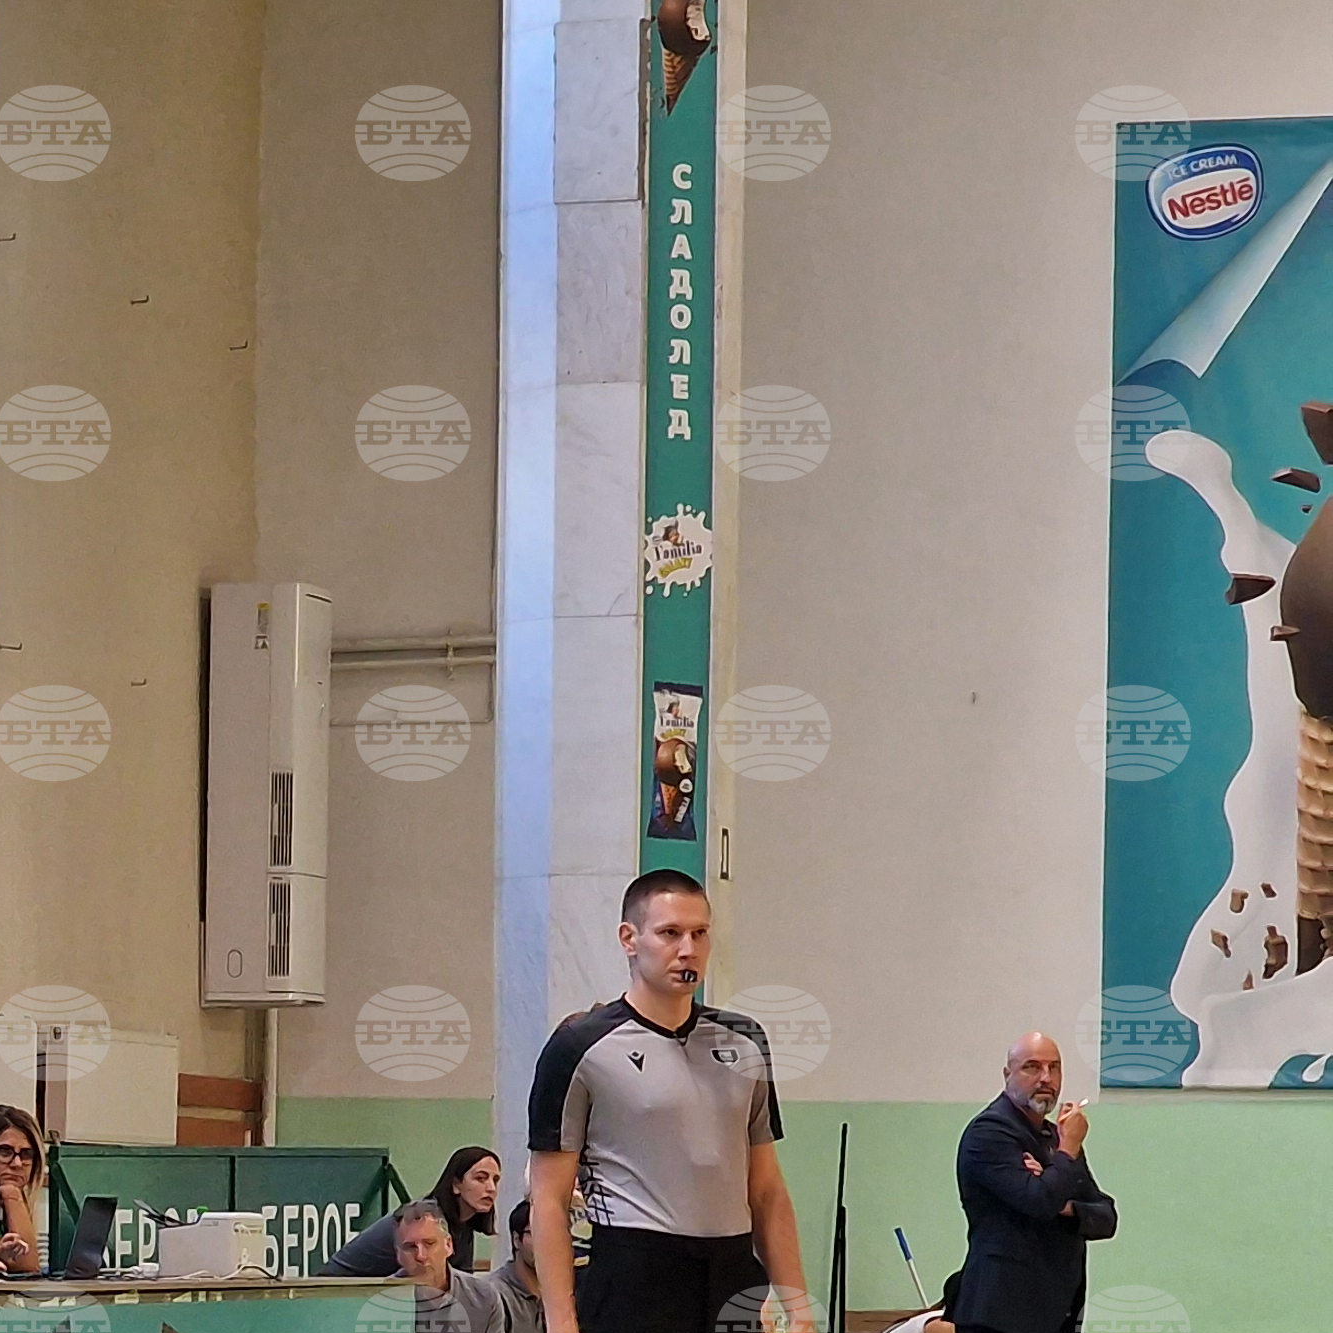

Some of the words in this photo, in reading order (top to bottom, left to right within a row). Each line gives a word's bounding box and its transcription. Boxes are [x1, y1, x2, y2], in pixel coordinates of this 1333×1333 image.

[1168, 165, 1188, 180] ICE
[1189, 154, 1238, 173] CREAM
[667, 163, 693, 440] СЛАДОЛЕД
